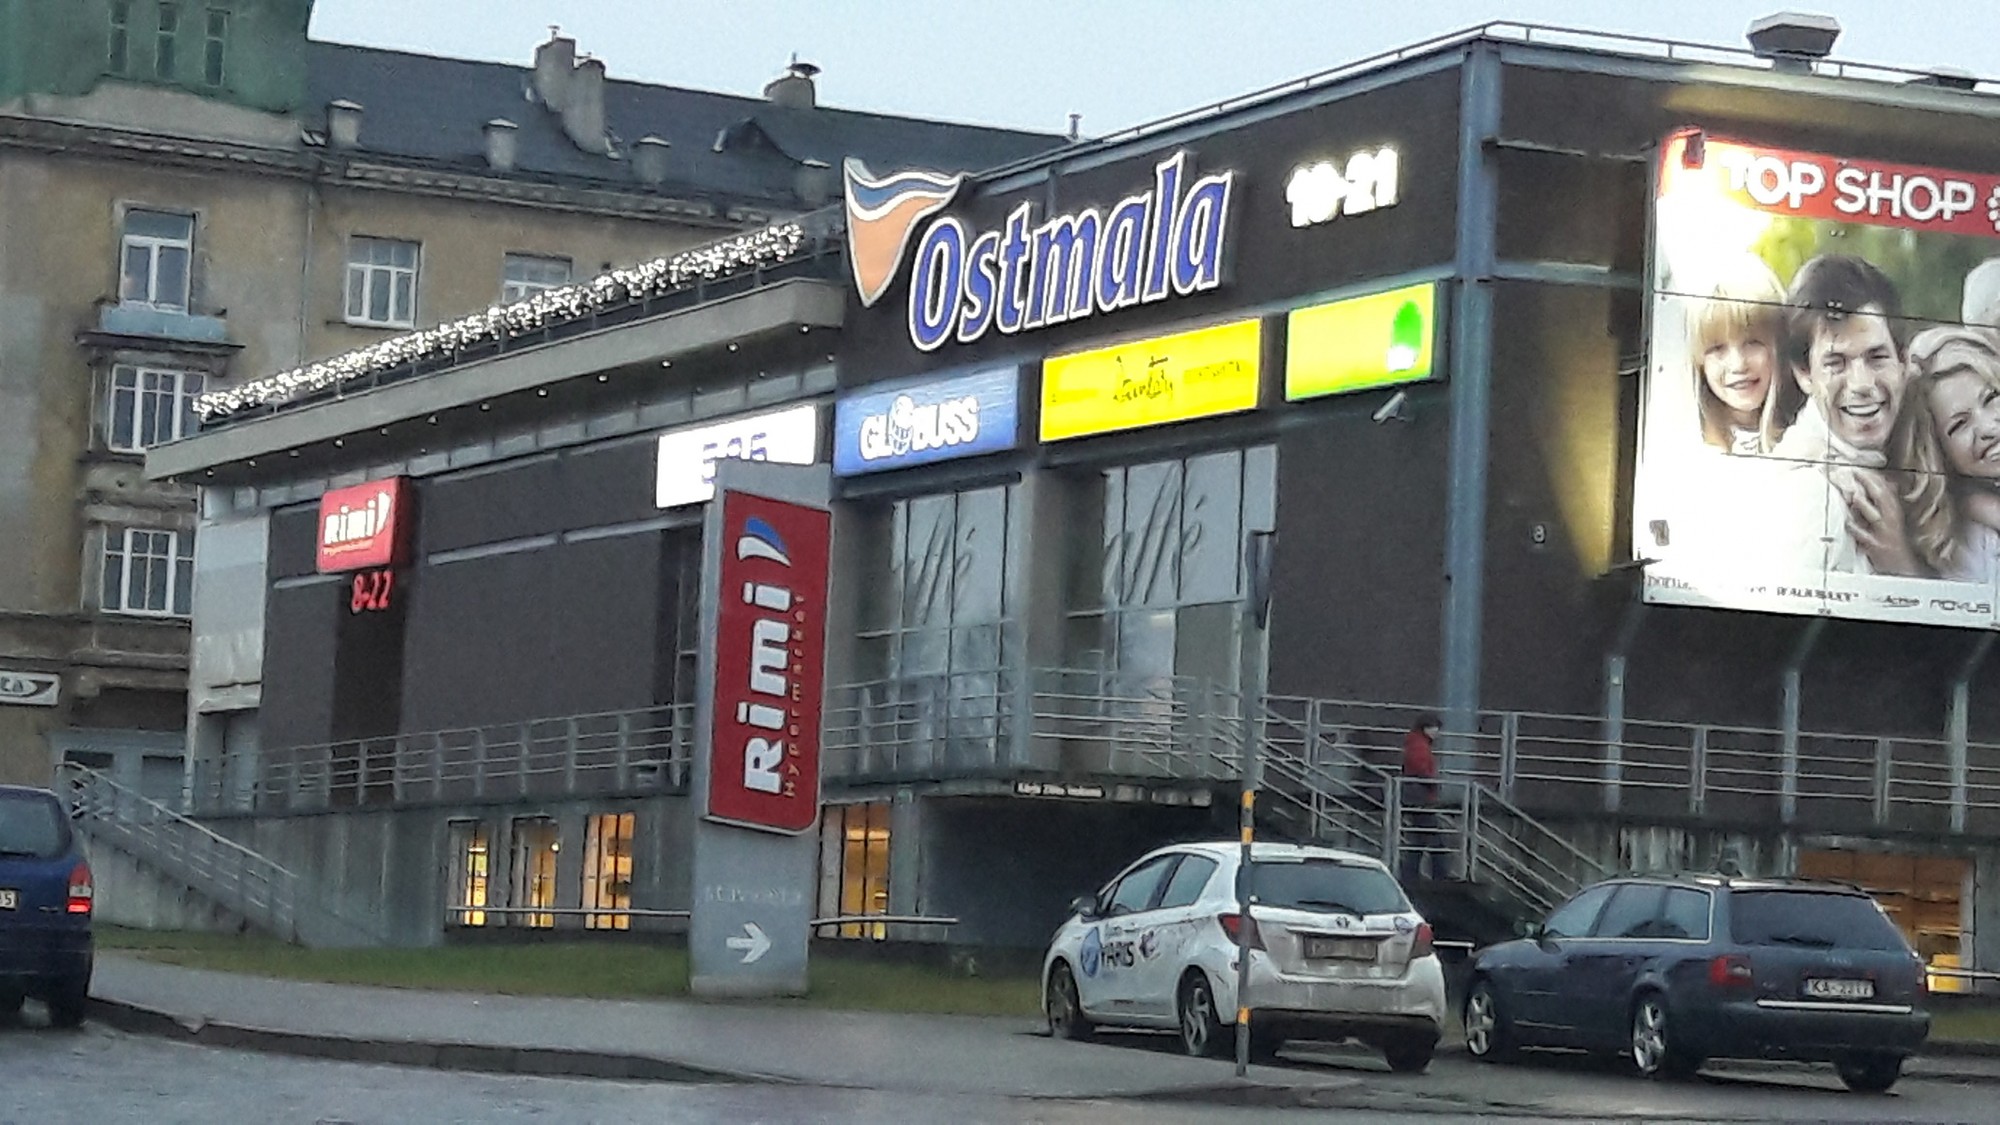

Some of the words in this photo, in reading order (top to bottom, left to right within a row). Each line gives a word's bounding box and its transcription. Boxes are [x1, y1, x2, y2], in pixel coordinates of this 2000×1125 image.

[909, 150, 1233, 351] Ostmala
[1719, 151, 1826, 208] TOP
[1834, 167, 1976, 221] SHOP
[736, 580, 792, 795] Rimi
